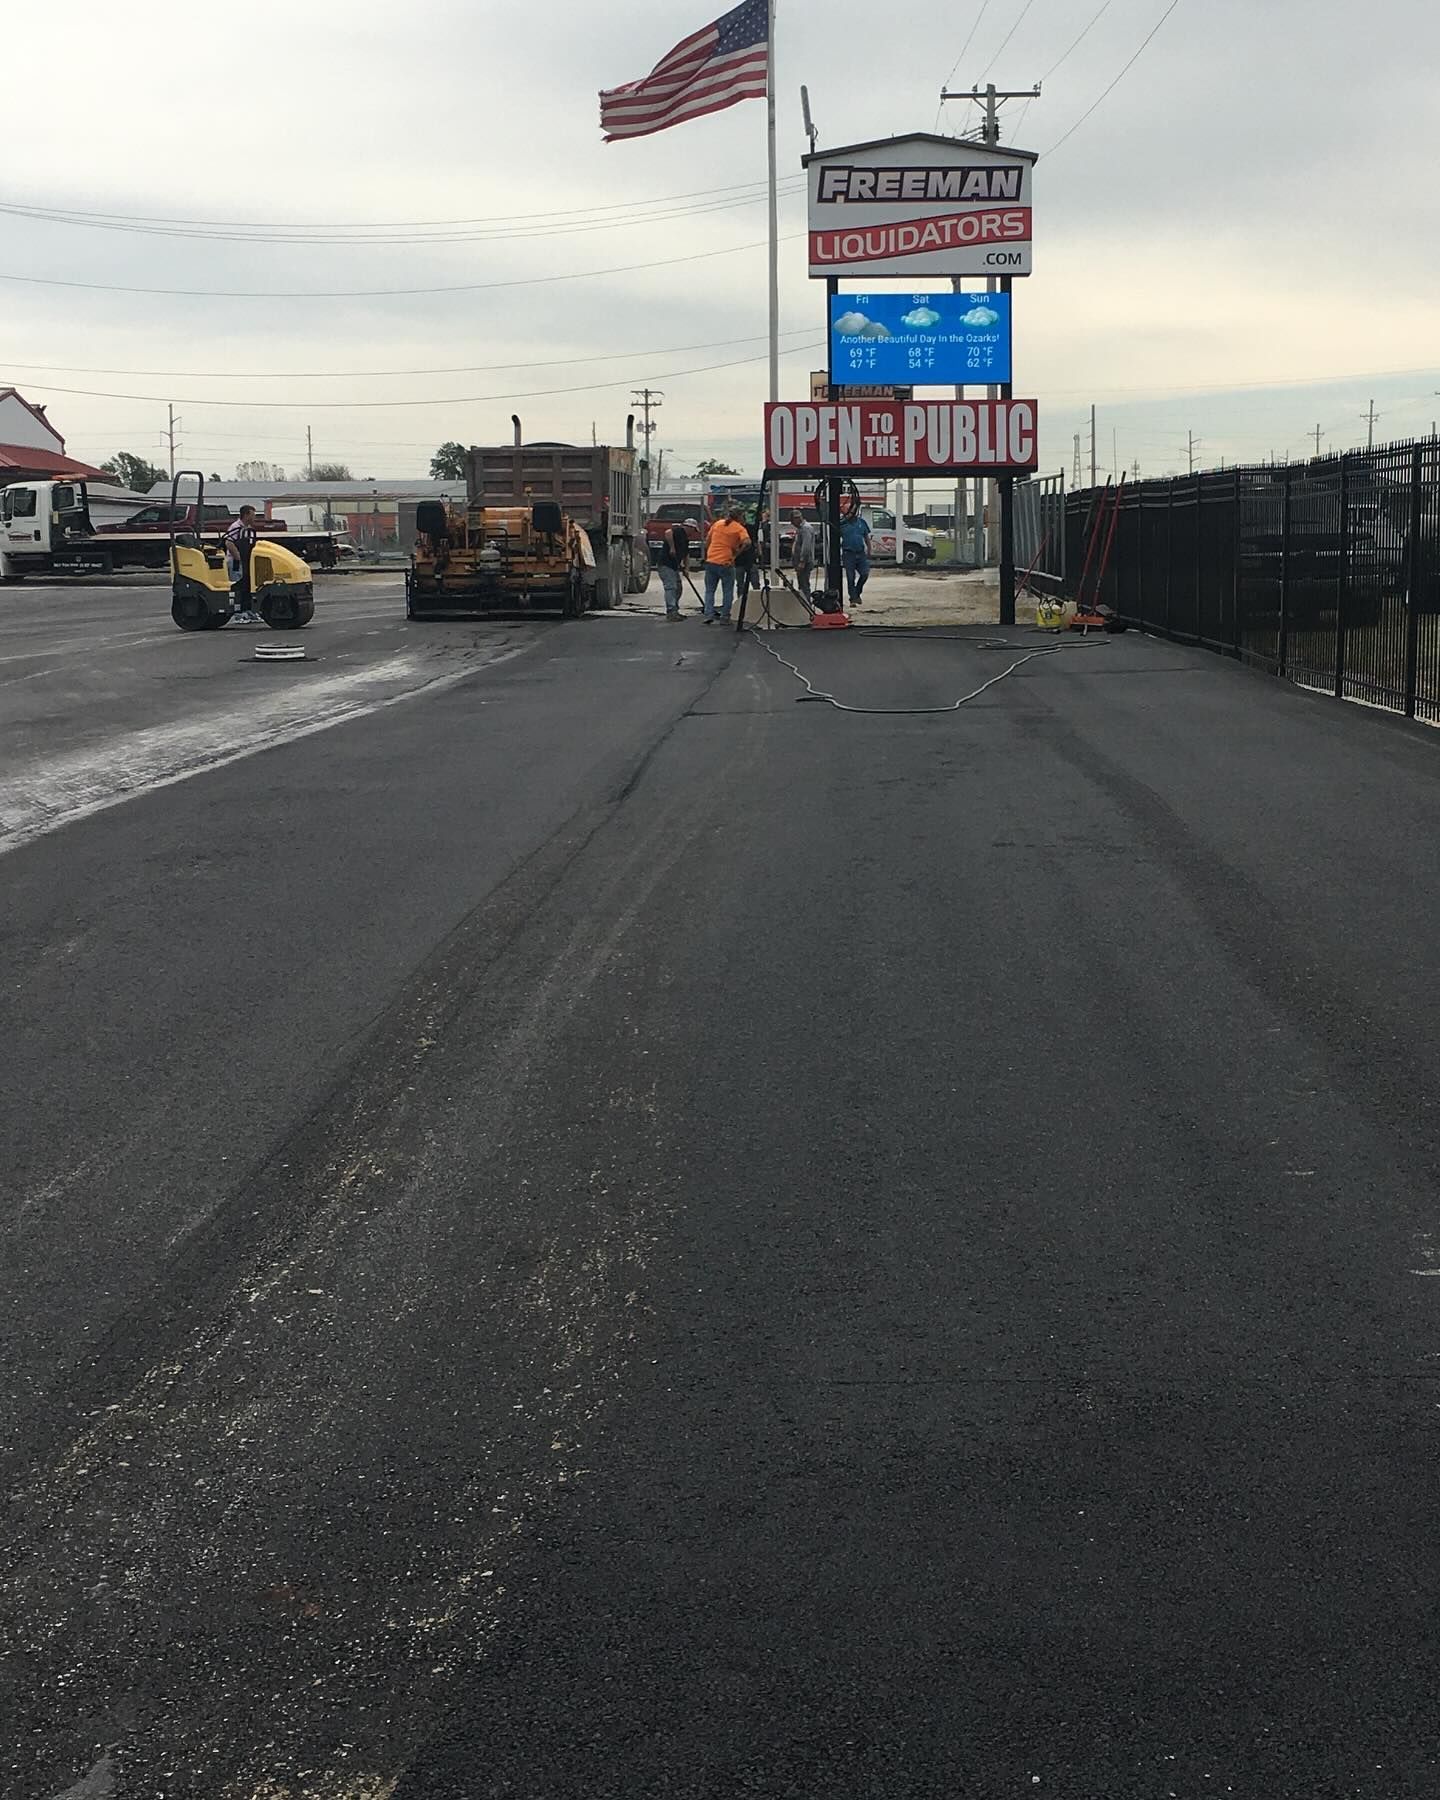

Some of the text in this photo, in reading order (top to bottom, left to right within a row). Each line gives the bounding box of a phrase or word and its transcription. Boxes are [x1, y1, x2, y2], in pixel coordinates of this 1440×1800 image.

[820, 168, 1020, 201] FREEMAN
[816, 212, 1025, 260] LIQUIDATORS
[982, 252, 1022, 266] .COM
[856, 294, 990, 305] Fri Sat Sun
[840, 335, 875, 344] Another
[878, 334, 918, 344] Beautiful
[920, 334, 936, 345] Day
[949, 334, 964, 343] the
[966, 333, 1000, 343] Ozarks!
[849, 348, 863, 358] 69
[908, 347, 922, 357] 68
[967, 346, 980, 357] 70
[849, 359, 863, 369] 47
[908, 359, 921, 369] 54
[967, 358, 980, 368] 62
[770, 403, 1033, 466] OPEN TO THE PUBLIC
